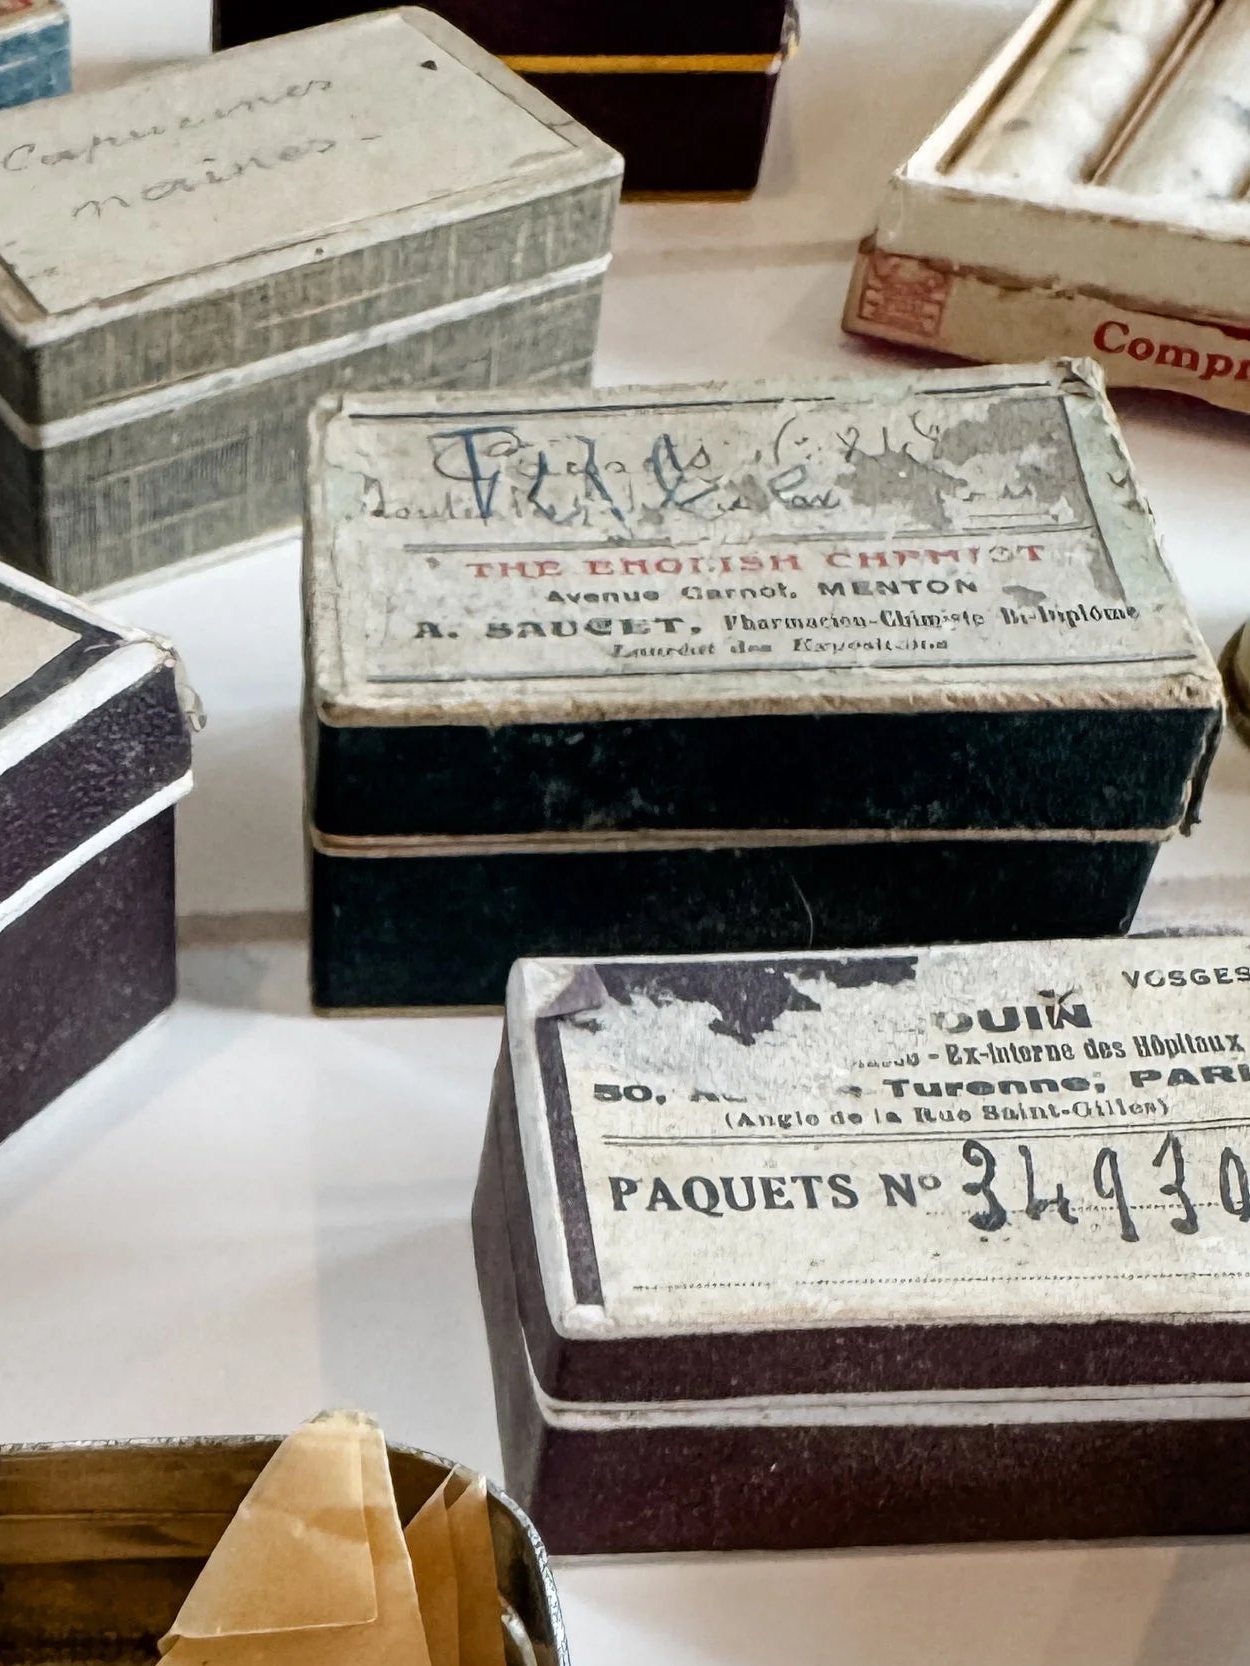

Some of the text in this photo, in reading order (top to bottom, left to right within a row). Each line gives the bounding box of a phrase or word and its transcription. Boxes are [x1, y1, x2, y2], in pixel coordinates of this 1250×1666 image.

[465, 559, 562, 580] THE
[817, 578, 980, 598] MENTON
[414, 620, 460, 641] A.
[1084, 1038, 1127, 1060] des
[874, 1108, 903, 1125] la
[608, 1173, 860, 1217] PAQUETS
